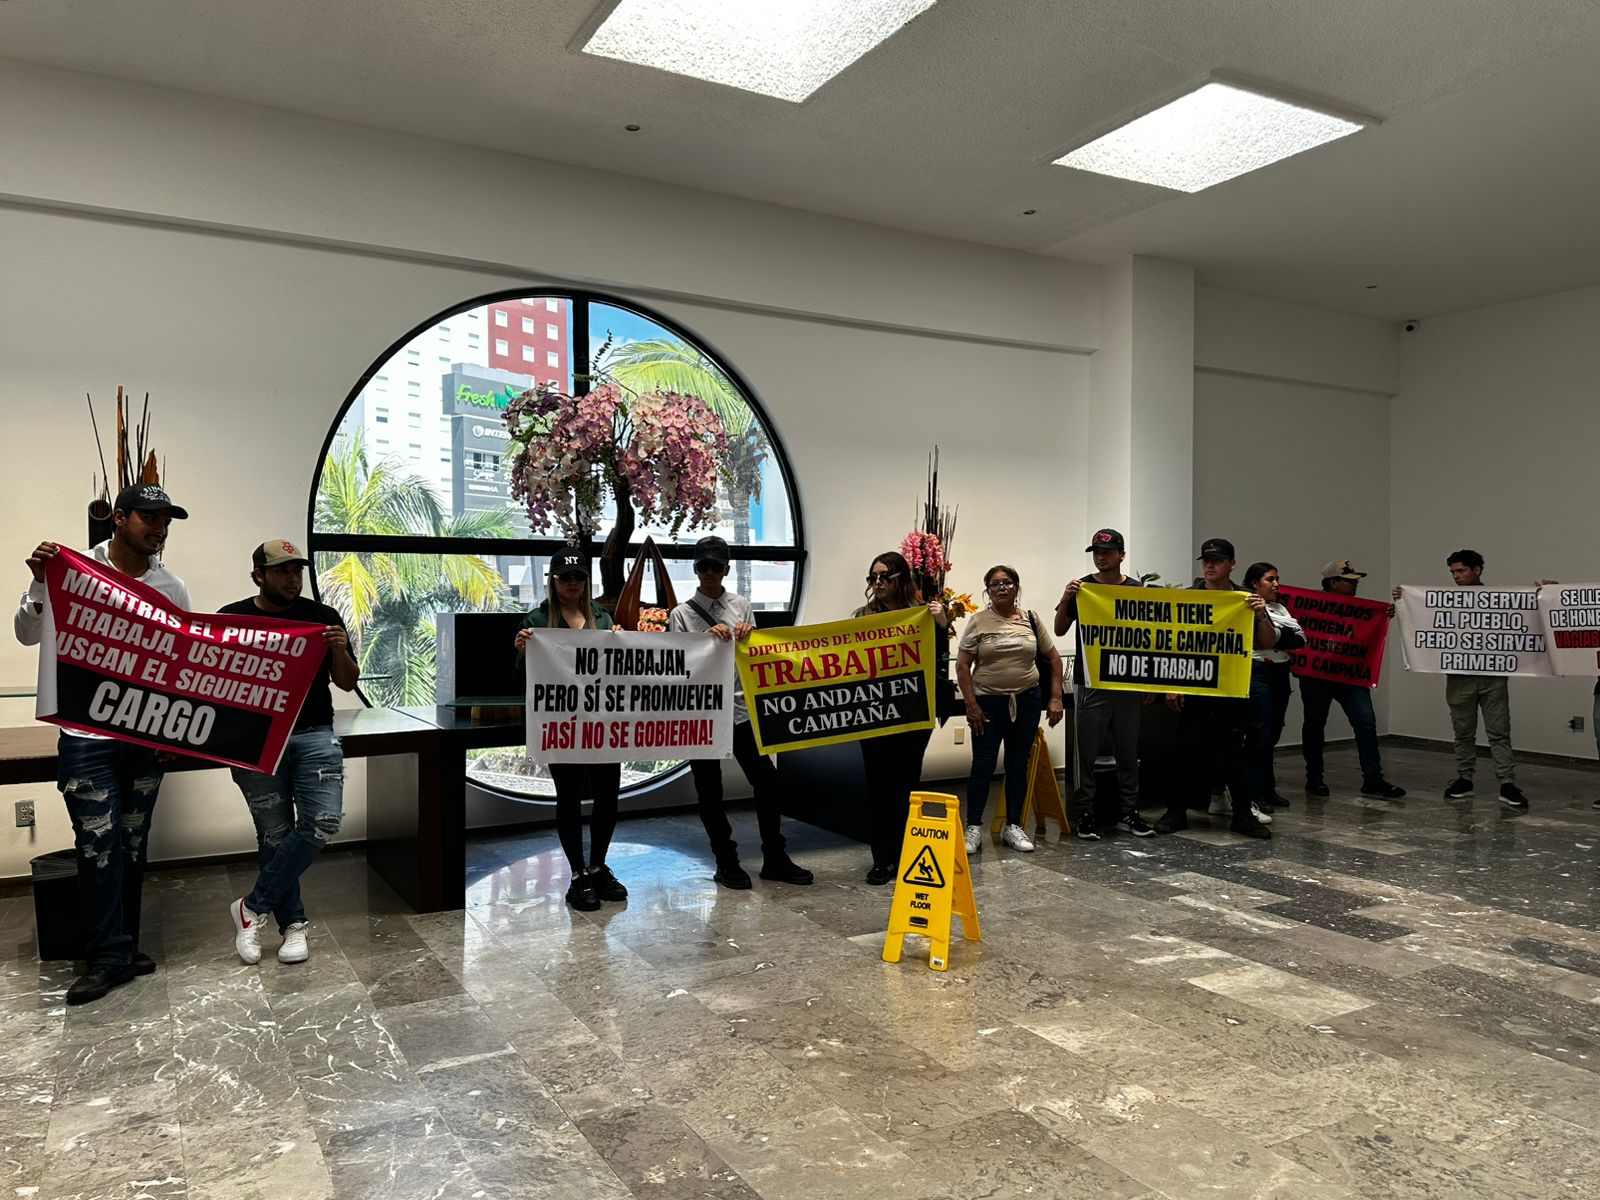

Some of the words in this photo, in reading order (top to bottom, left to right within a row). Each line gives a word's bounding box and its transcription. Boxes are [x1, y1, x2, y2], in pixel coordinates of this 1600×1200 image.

[564, 556, 579, 565] NY
[1293, 596, 1373, 620] DIPUTADOS
[1425, 591, 1474, 609] DICEN
[1477, 591, 1539, 610] SERVIR
[1560, 589, 1578, 606] SE
[61, 568, 182, 629] MIENTRAS
[189, 620, 215, 639] EL
[222, 627, 307, 658] PUEBLO
[1114, 599, 1172, 623] MORENA
[1176, 603, 1213, 625] TIENE
[1434, 611, 1455, 628] AL
[1459, 611, 1528, 632] PUEBLO,
[1549, 609, 1569, 628] DE
[66, 601, 179, 659] TRABAJA,
[188, 643, 286, 682] USTEDES
[747, 637, 830, 658] DIPUTADOS
[832, 633, 851, 646] DE
[855, 624, 920, 643] MORENA:
[1080, 624, 1151, 649] DIPUTADOS
[1155, 629, 1172, 651] DE
[1177, 628, 1248, 657] CAMPAÑA,
[1415, 631, 1458, 649] PERO
[1461, 632, 1483, 650] SE
[1485, 633, 1546, 652] SIRVEN
[55, 629, 139, 677] USCAN
[141, 658, 167, 686] EL
[175, 670, 290, 713] SIGUIENTE
[575, 648, 598, 675] NO
[604, 648, 691, 679] TRABAJAN,
[750, 640, 922, 689] TRABAJEN
[1108, 654, 1127, 676] NO
[1131, 656, 1148, 677] DE
[1152, 657, 1213, 681] TRABAJO
[1441, 653, 1517, 672] PRIMERO
[534, 684, 578, 712] PERO
[584, 678, 601, 712] SÍ
[605, 684, 625, 712] SE
[630, 684, 723, 712] PROMUEVEN
[763, 695, 797, 716] NO
[803, 683, 884, 711] ANDAN
[888, 676, 919, 697] EN
[88, 681, 217, 746] CARGO
[788, 701, 901, 735] CAMPAÑA
[541, 715, 577, 751] ¡ASÍ
[581, 722, 604, 749] NO
[609, 722, 630, 748] SE
[634, 720, 714, 747] GOBIERNA!
[910, 827, 949, 840] CAUTION
[910, 901, 931, 911] FLOOR
[915, 892, 929, 901] WET
